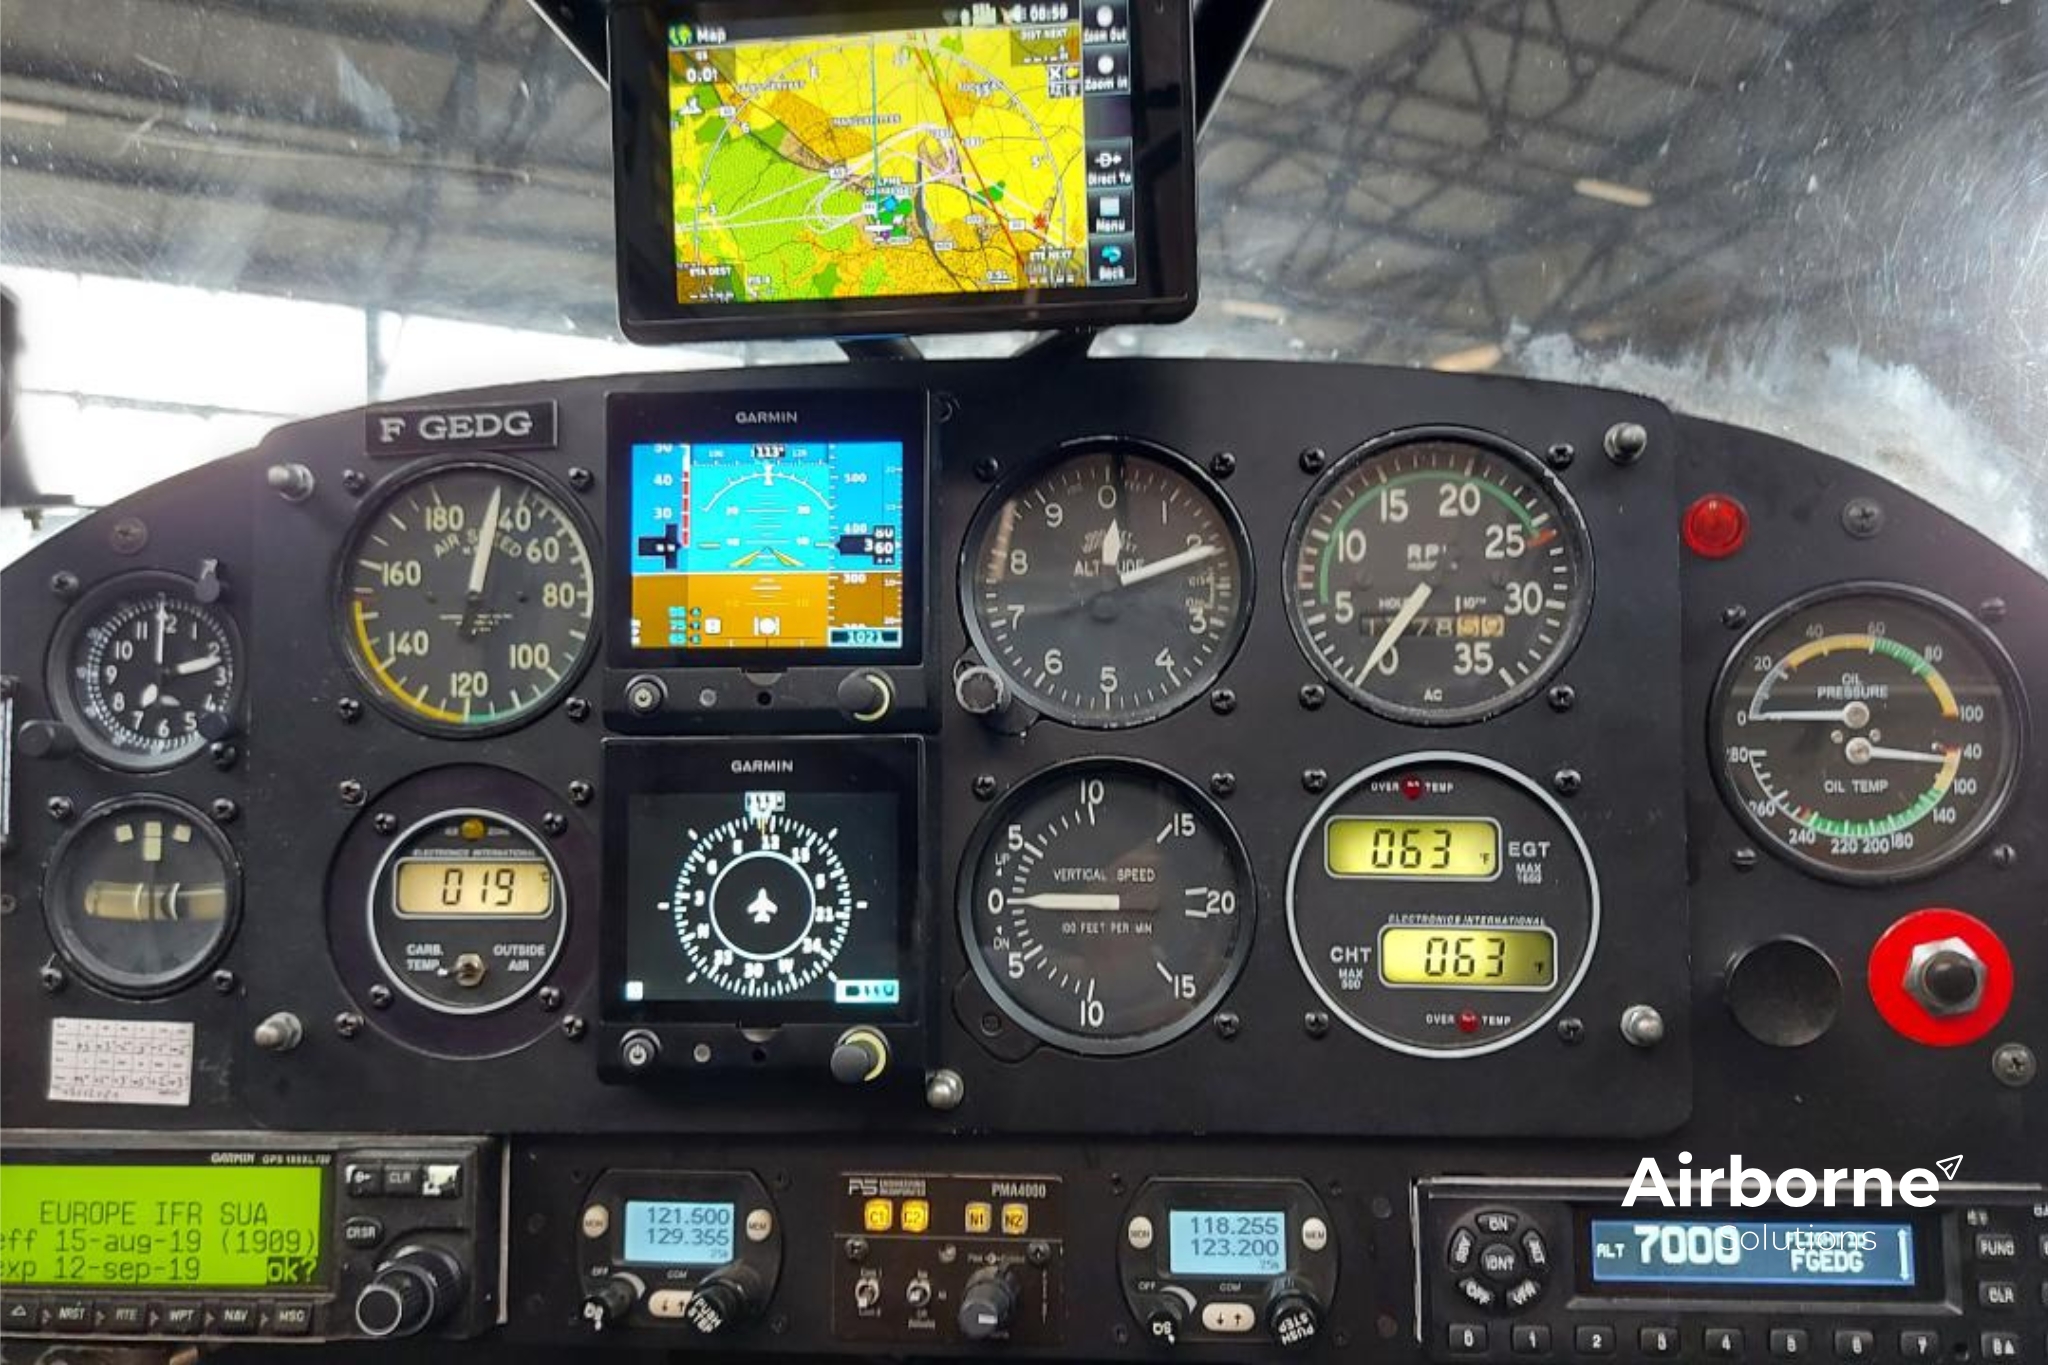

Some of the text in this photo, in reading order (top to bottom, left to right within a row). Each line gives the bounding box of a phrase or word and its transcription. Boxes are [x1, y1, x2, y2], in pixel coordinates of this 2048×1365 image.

[697, 26, 726, 43] Map
[1084, 77, 1114, 91] Zoom
[380, 411, 533, 442] F GEDG
[735, 411, 798, 424] GARMIN
[654, 474, 672, 486] 40
[1098, 485, 1116, 509] 0
[1381, 489, 1409, 523] 15
[1439, 483, 1481, 517] 20
[426, 504, 464, 531] 180
[498, 505, 532, 532] 40
[654, 507, 672, 519] 30
[1045, 503, 1063, 528] 9
[1162, 499, 1168, 525] 1
[526, 536, 560, 563] 60
[1338, 530, 1367, 563] 10
[1485, 525, 1525, 559] 25
[1010, 549, 1028, 576] 8
[383, 560, 421, 586] 160
[543, 582, 575, 608] 80
[1504, 582, 1543, 615] 30
[1335, 591, 1353, 623] 5
[1007, 605, 1025, 630] 7
[1188, 606, 1207, 635] 3
[137, 621, 148, 640] 11
[192, 621, 198, 641] 1
[1806, 623, 1824, 639] 40
[1868, 622, 1885, 637] 60
[116, 641, 133, 660] 10
[389, 630, 430, 656] 140
[509, 643, 550, 669] 100
[1044, 650, 1063, 674] 6
[1155, 649, 1174, 668] 4
[1379, 643, 1399, 676] 0
[1454, 643, 1494, 675] 35
[1925, 645, 1943, 661] 80
[1754, 655, 1772, 671] 20
[106, 665, 117, 684] 9
[215, 666, 227, 687] 3
[1100, 667, 1118, 692] 5
[1842, 673, 1862, 685] OIL
[451, 672, 488, 697] 120
[1817, 686, 1888, 699] PRESSURE
[113, 692, 125, 711] 8
[205, 693, 217, 712] 4
[1424, 689, 1443, 701] AC
[133, 711, 144, 730] 7
[185, 711, 197, 731] 5
[1737, 708, 1746, 725] 0
[1960, 704, 1984, 722] 100
[158, 718, 169, 738] 6
[1964, 742, 1982, 759] 40
[731, 760, 794, 773] GARMIN
[1080, 781, 1104, 804] 10
[1371, 781, 1454, 792] OVER TEMP
[1824, 779, 1889, 793] OIL TEMP
[1954, 777, 1977, 795] 100
[1174, 813, 1196, 836] 15
[1933, 809, 1956, 824] 140
[1008, 825, 1024, 850] 5
[1788, 828, 1816, 845] 240
[1831, 837, 1858, 854] 220
[1863, 837, 1889, 854] 200
[1891, 833, 1914, 850] 180
[1371, 828, 1452, 869] 063
[1508, 841, 1551, 858] EGT
[1053, 867, 1156, 882] VERTICAL SPEED
[1515, 863, 1542, 873] MAX
[442, 868, 515, 905] 019
[987, 889, 1004, 913] 0
[1206, 891, 1235, 914] 20
[1080, 922, 1104, 934] FEET
[1111, 922, 1130, 934] PER
[1388, 913, 1546, 926] ELECTRONICS INTERNATIONAL
[493, 944, 546, 956] OUTSIDE
[994, 938, 1010, 951] DN
[1330, 946, 1372, 963] CHT
[1424, 937, 1506, 977] 063
[508, 959, 530, 971] AIR
[1009, 952, 1025, 979] 5
[1339, 968, 1364, 979] MAX
[1174, 975, 1197, 998] 15
[1080, 1001, 1104, 1027] 10
[1426, 1014, 1512, 1026] OVER TEMP
[211, 1152, 255, 1164] GARMIN
[389, 1173, 411, 1184] CLR
[991, 1182, 1047, 1198] PMA4000
[40, 1201, 268, 1226] EUROPE IFR SUA
[647, 1207, 731, 1224] 121.500
[970, 1211, 984, 1226] N1
[1005, 1213, 1023, 1227] N2
[346, 1226, 376, 1239] CRSR
[1190, 1216, 1280, 1235] 118.255
[1489, 1216, 1508, 1231] ON
[55, 1228, 317, 1254] 15-aug-19 (1909)
[647, 1228, 730, 1245] 129.355
[1632, 1224, 1742, 1265] 7000
[1190, 1239, 1280, 1256] 123.200
[1596, 1243, 1626, 1260] ALT
[54, 1255, 318, 1283] 12-sep-19 ok?
[1790, 1249, 1865, 1273] FGEDG
[667, 1269, 688, 1279] COM
[1138, 1280, 1156, 1291] OFF
[1219, 1283, 1242, 1292] COM
[59, 1308, 85, 1320] NRST
[116, 1308, 137, 1320] RTE
[169, 1309, 194, 1321] WPT
[224, 1309, 248, 1321] NAV
[279, 1309, 304, 1321] MSG
[1464, 1329, 1474, 1347] 0
[1528, 1331, 1536, 1348] 1
[1592, 1334, 1602, 1349] 2
[1918, 1336, 1927, 1353] 7
